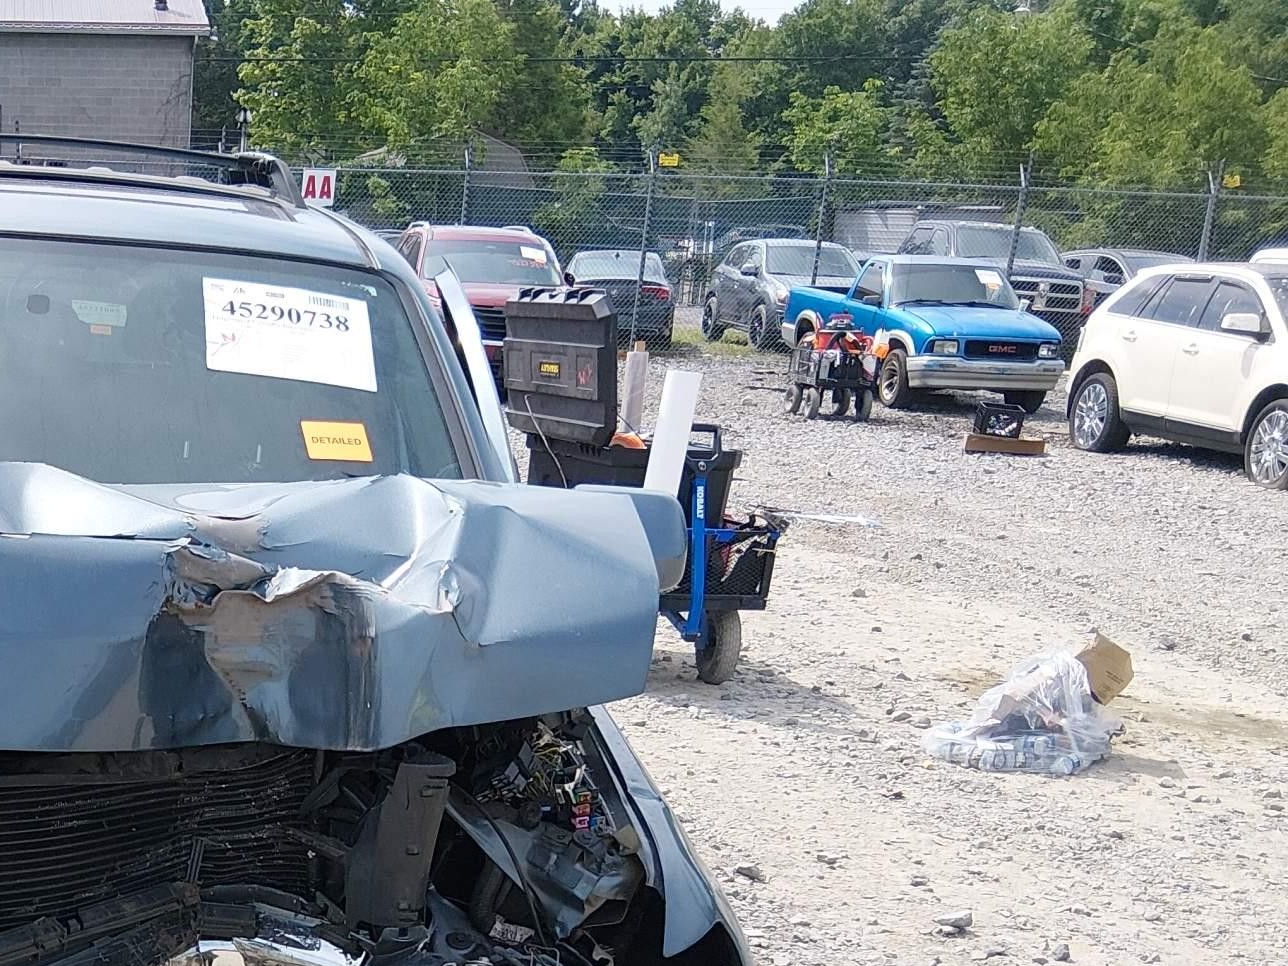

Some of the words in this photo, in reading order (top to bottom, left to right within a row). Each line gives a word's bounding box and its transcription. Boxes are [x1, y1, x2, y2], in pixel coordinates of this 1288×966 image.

[303, 175, 332, 199] AA
[221, 299, 351, 333] 45290738
[988, 345, 1017, 353] GMC
[311, 436, 362, 446] DETAILED
